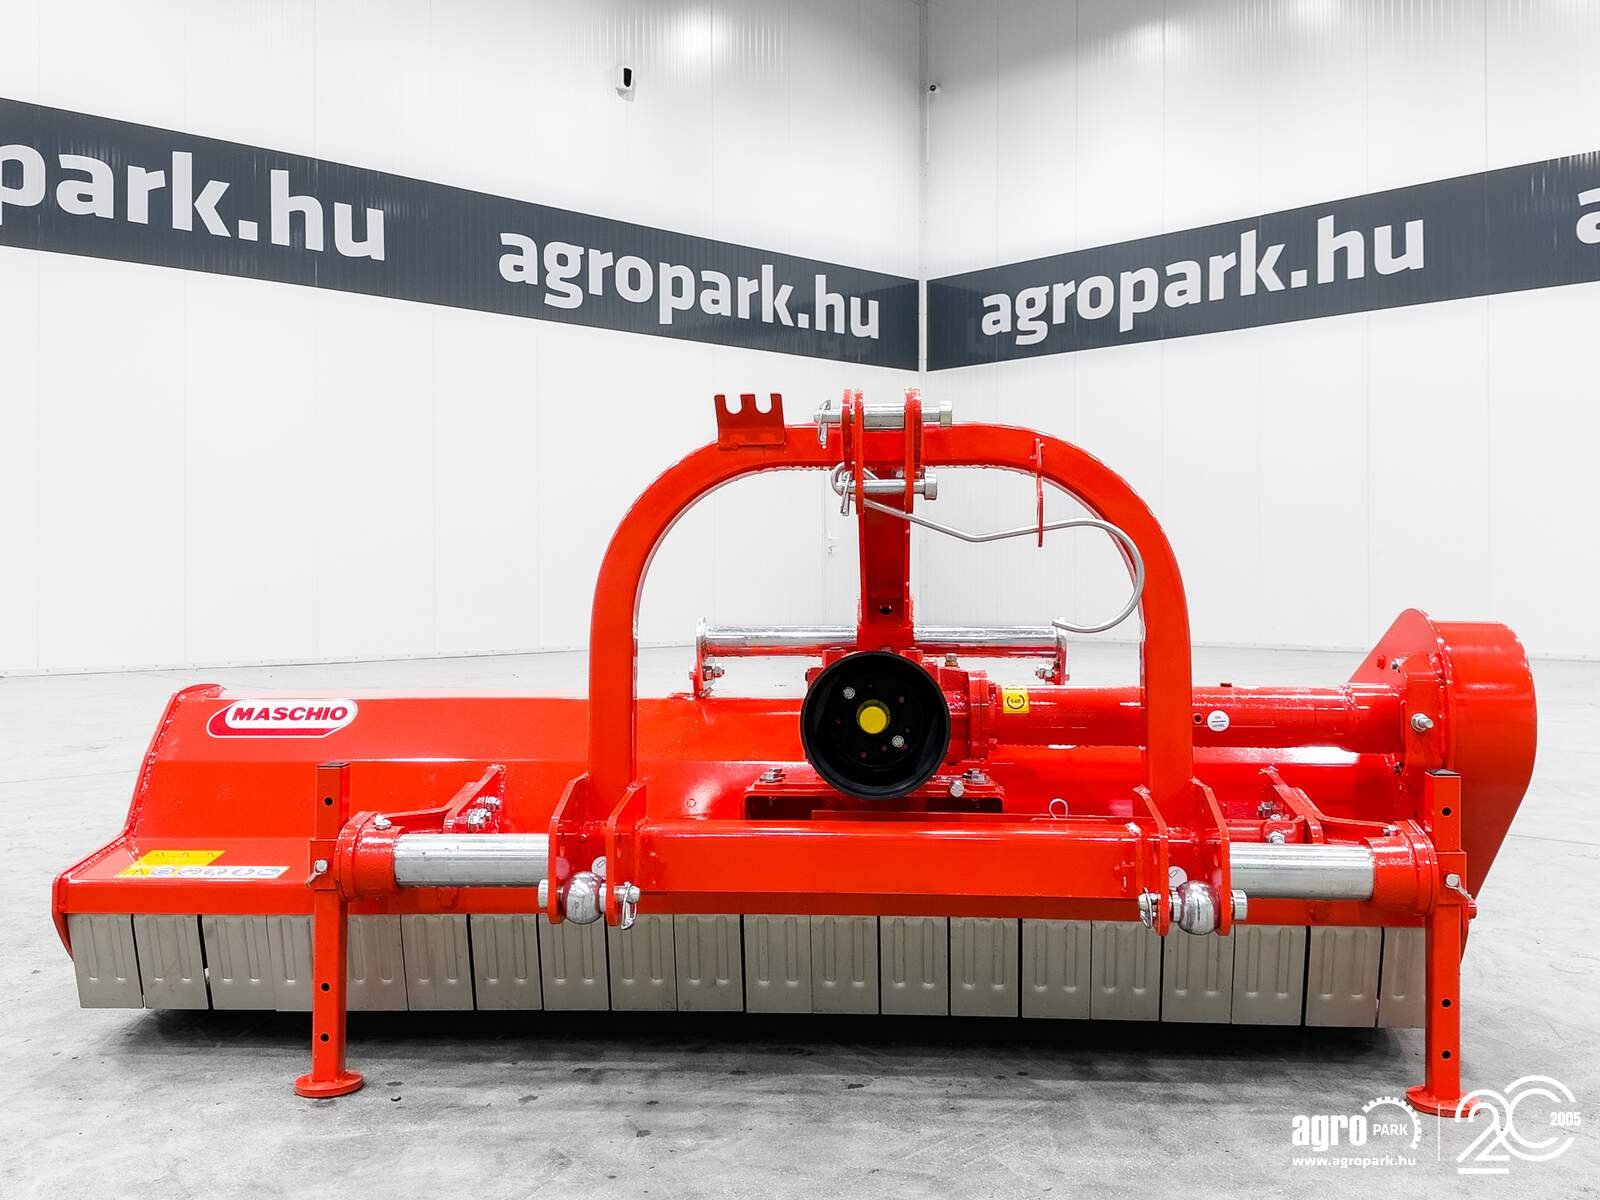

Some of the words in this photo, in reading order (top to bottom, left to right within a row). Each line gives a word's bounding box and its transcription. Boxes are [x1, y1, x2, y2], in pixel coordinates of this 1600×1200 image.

[498, 232, 880, 340] agropark.hu
[981, 214, 1424, 345] agropark.hu
[232, 706, 348, 721] MASCHIO
